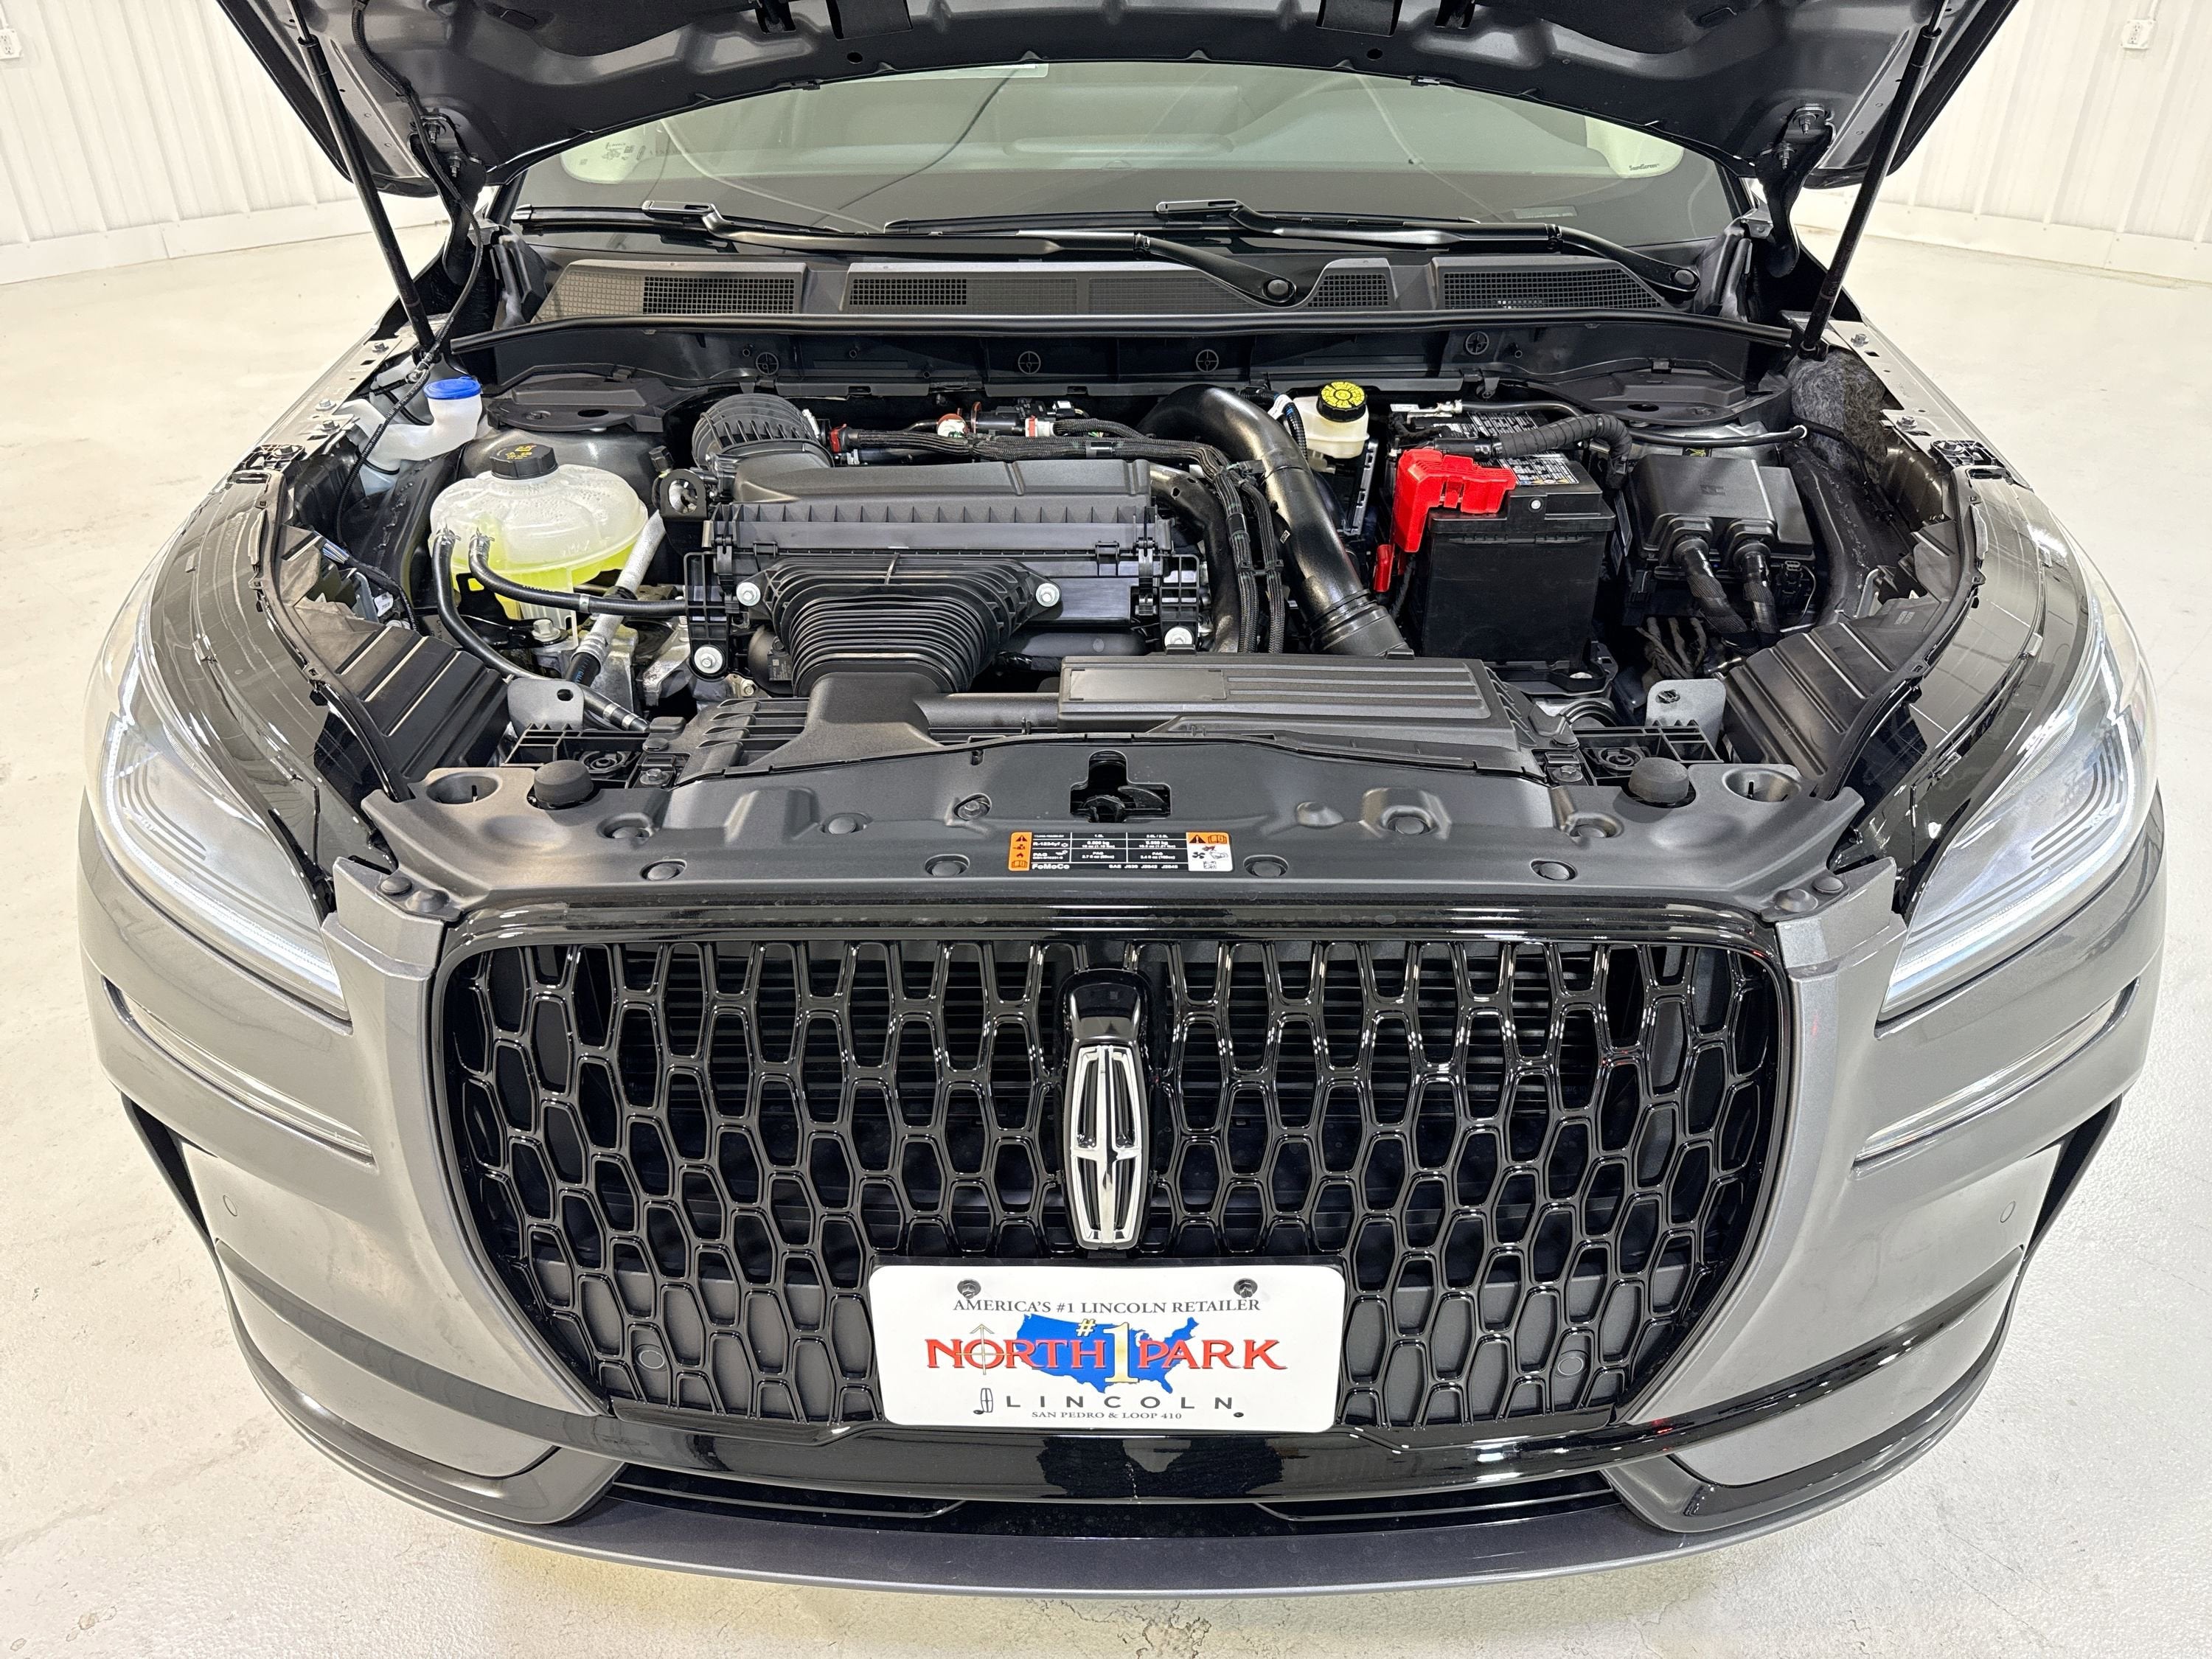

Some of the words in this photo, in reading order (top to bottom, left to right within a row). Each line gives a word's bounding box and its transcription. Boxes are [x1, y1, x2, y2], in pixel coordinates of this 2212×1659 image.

[953, 1299, 1051, 1312] AMERICA'S
[1056, 1302, 1075, 1313] #1
[1080, 1302, 1167, 1314] LINCOLN
[1172, 1298, 1261, 1312] RETAILER
[925, 1338, 1106, 1370] NORTH
[1138, 1338, 1289, 1370] PARK
[1006, 1395, 1232, 1411] LINCOLN
[1061, 1411, 1105, 1419] PEDRO
[1108, 1411, 1117, 1419] &
[1161, 1411, 1182, 1420] 410
